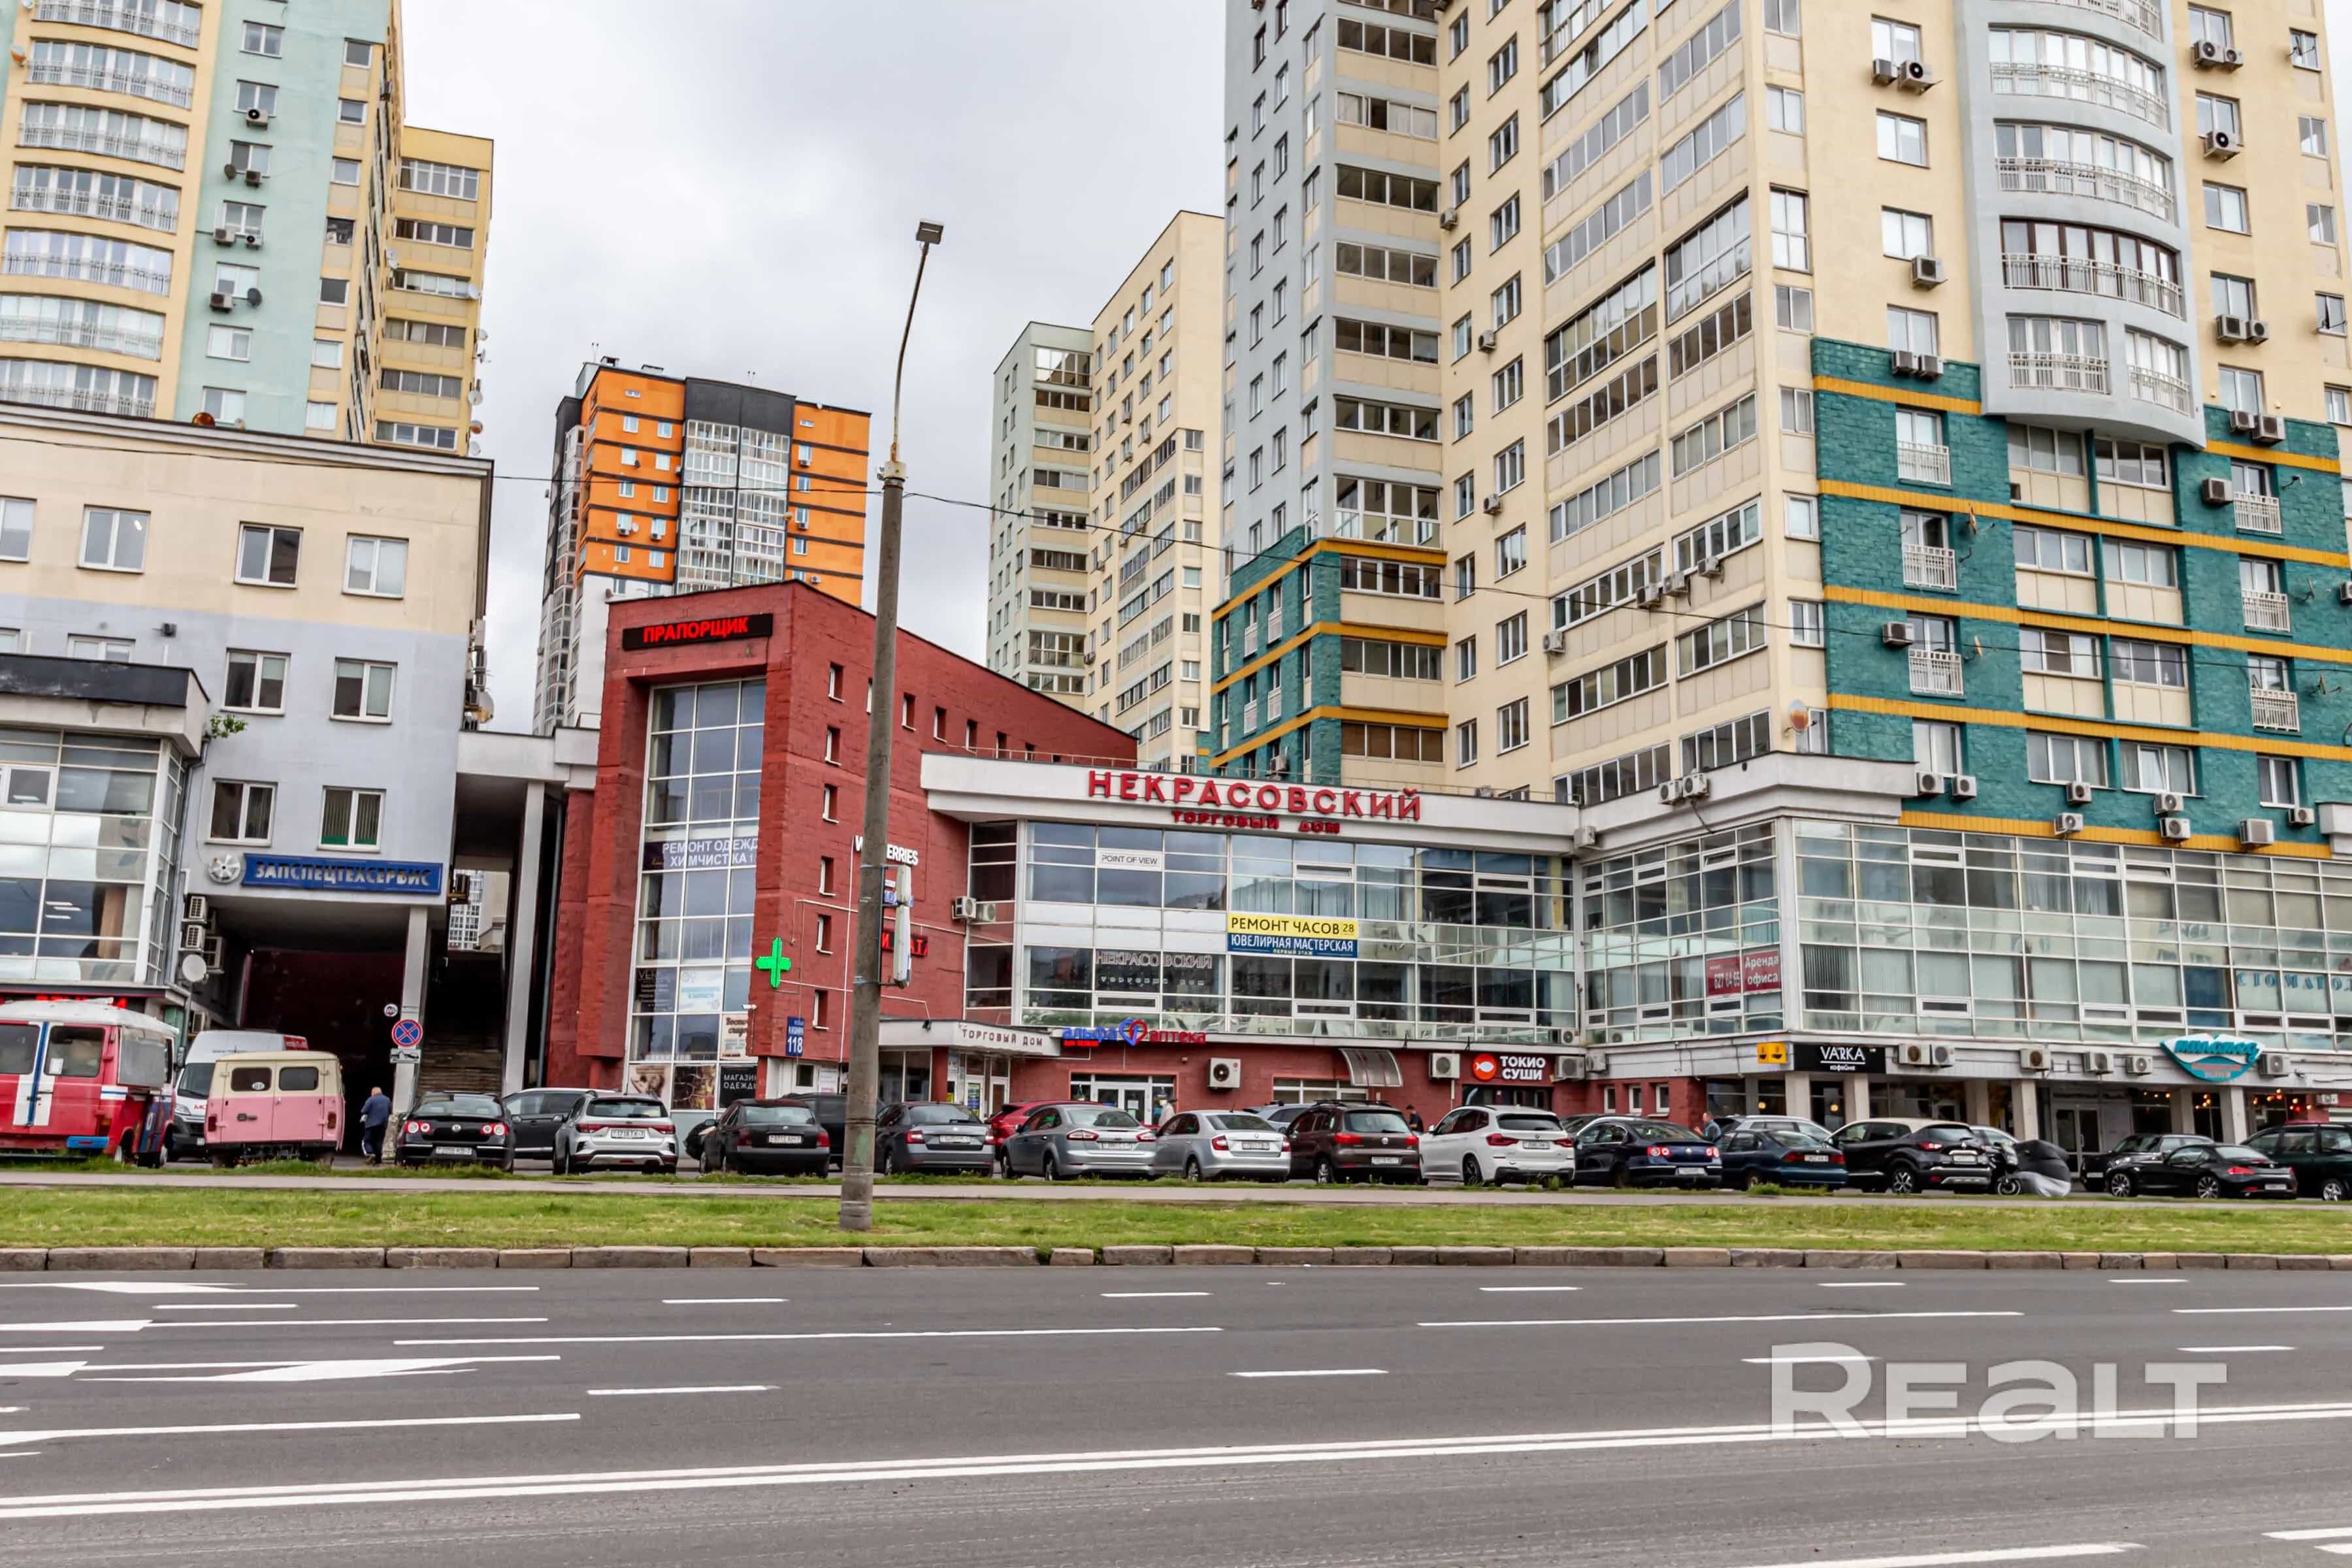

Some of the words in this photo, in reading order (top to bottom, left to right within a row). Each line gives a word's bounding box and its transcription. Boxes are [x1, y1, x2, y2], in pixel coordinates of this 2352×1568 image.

[643, 617, 749, 643] ПРАПОРЩИК
[1088, 770, 1421, 821] НЕКРАСОВСКИЙ
[1171, 811, 1279, 830] ТОРГОВЫЙ
[1298, 821, 1341, 834] ДОМ
[662, 841, 712, 853] РЕМОНТ
[855, 835, 919, 866] WERRIES
[670, 853, 747, 867] ХИМЧИСТКА
[1102, 855, 1125, 863] POINT
[254, 861, 432, 886] ЗАПСПЕЦТЕХСЕРВИС
[1232, 917, 1289, 932] РЕМОНТ
[1292, 922, 1339, 935] ЧАСОВ
[1342, 924, 1354, 933] 28
[1231, 934, 1291, 949] ЮВЕЛИРНАЯ
[1294, 938, 1353, 952] МАСТЕРСКАЯ
[1745, 955, 1779, 970] Аренда
[1748, 972, 1778, 987] офиса
[962, 1028, 1017, 1043] ТОРГОВЫЙ
[1022, 1035, 1043, 1046] ДОМ
[1062, 1026, 1117, 1042] альфа
[1149, 1030, 1207, 1044] аптека
[787, 1036, 803, 1053] 118
[1499, 1056, 1546, 1068] ТОКИО
[1820, 1046, 1865, 1061] VARKA
[1502, 1068, 1543, 1080] СУШИ
